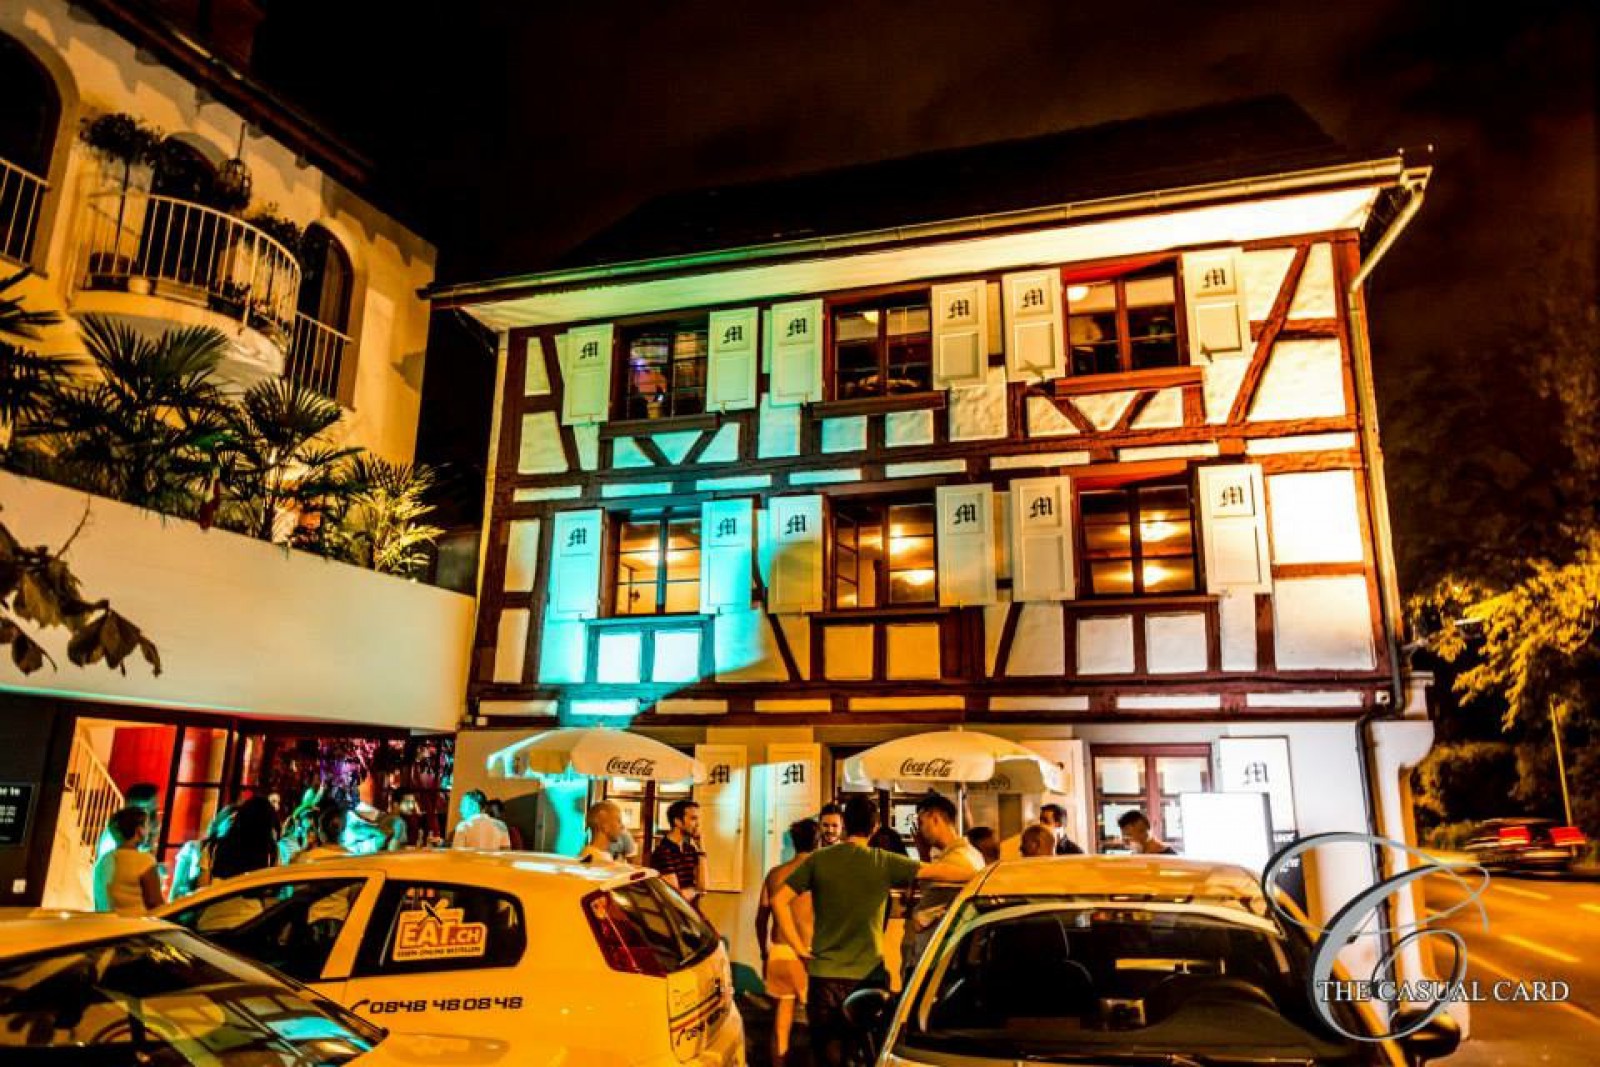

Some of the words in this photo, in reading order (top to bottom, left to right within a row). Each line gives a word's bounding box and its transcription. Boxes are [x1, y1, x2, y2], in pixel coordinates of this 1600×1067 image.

[1203, 267, 1226, 288] M
[1021, 288, 1043, 308] M
[947, 299, 969, 319] M
[722, 326, 742, 344] M
[786, 317, 807, 337] M
[579, 341, 598, 359] M
[1219, 485, 1243, 507] M
[953, 503, 976, 524] M
[1029, 496, 1052, 518] M
[715, 517, 736, 537] M
[784, 514, 806, 534] M
[567, 527, 587, 547] M
[708, 764, 730, 785] M
[781, 764, 804, 785] M
[1243, 761, 1269, 785] M
[401, 920, 480, 947] EAT.CH
[369, 999, 427, 1014] 0848
